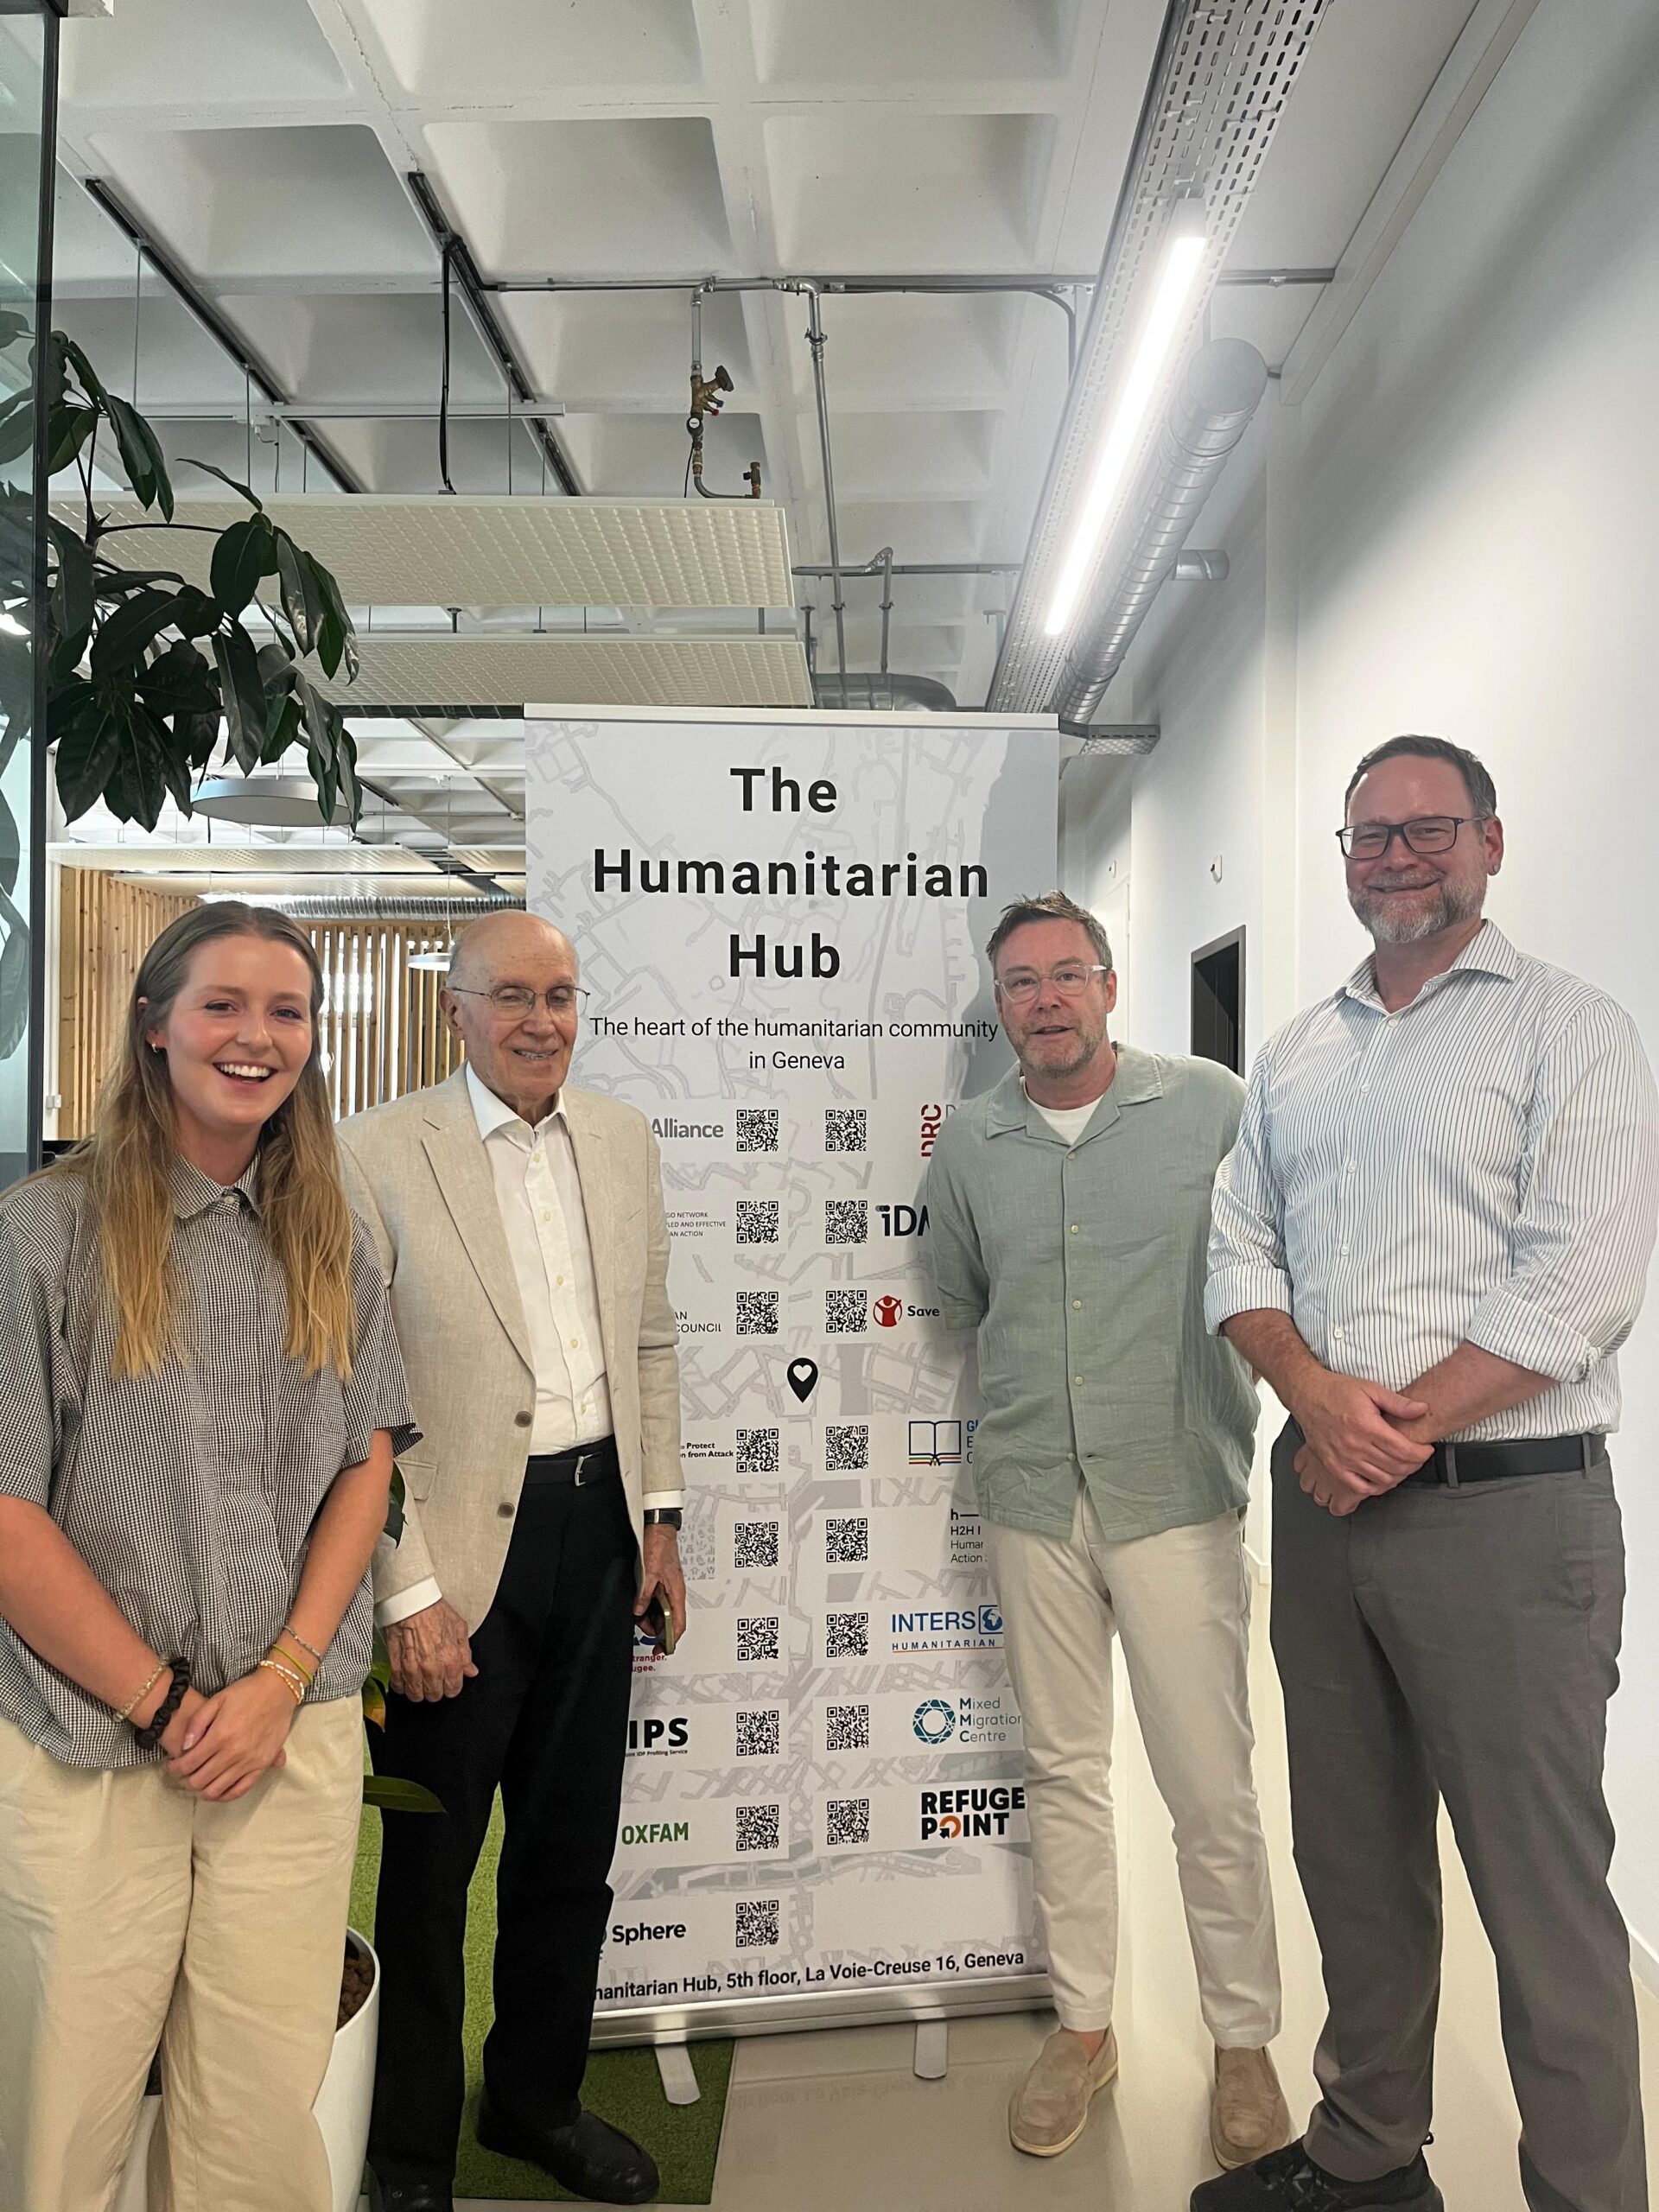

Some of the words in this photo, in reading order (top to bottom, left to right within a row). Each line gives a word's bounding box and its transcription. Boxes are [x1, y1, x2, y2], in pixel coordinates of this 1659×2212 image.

[730, 767, 837, 812] The
[594, 849, 988, 897] Humanitarian
[729, 933, 840, 978] Hub
[589, 1018, 628, 1035] The
[635, 1017, 685, 1035] heart
[691, 1018, 712, 1036] of
[717, 1018, 748, 1036] the
[755, 1018, 883, 1037] humanitarian
[889, 1020, 998, 1042] community
[749, 1052, 766, 1069] in
[772, 1052, 844, 1069] Geneva
[652, 1118, 724, 1138] Alliance
[907, 1306, 940, 1317] Save
[677, 1323, 721, 1332] OUNCIL
[950, 1525, 975, 1535] H2H
[950, 1554, 982, 1563] Action
[892, 1638, 996, 1651] HUMANITARIAN
[960, 1696, 1001, 1710] Mixed
[959, 1730, 1007, 1743] Centre
[921, 1787, 1026, 1815] REFUGE
[622, 1821, 689, 1845] OXFAM
[612, 1923, 687, 1946] Sphere
[683, 1974, 721, 1993] Hub,
[727, 1971, 753, 1988] 5th
[758, 1969, 801, 1986] floor,
[805, 1967, 825, 1982] La
[830, 1959, 931, 1980] Voie-Creuse
[936, 1955, 961, 1973] 16,
[964, 1953, 1024, 1968] Geneva
